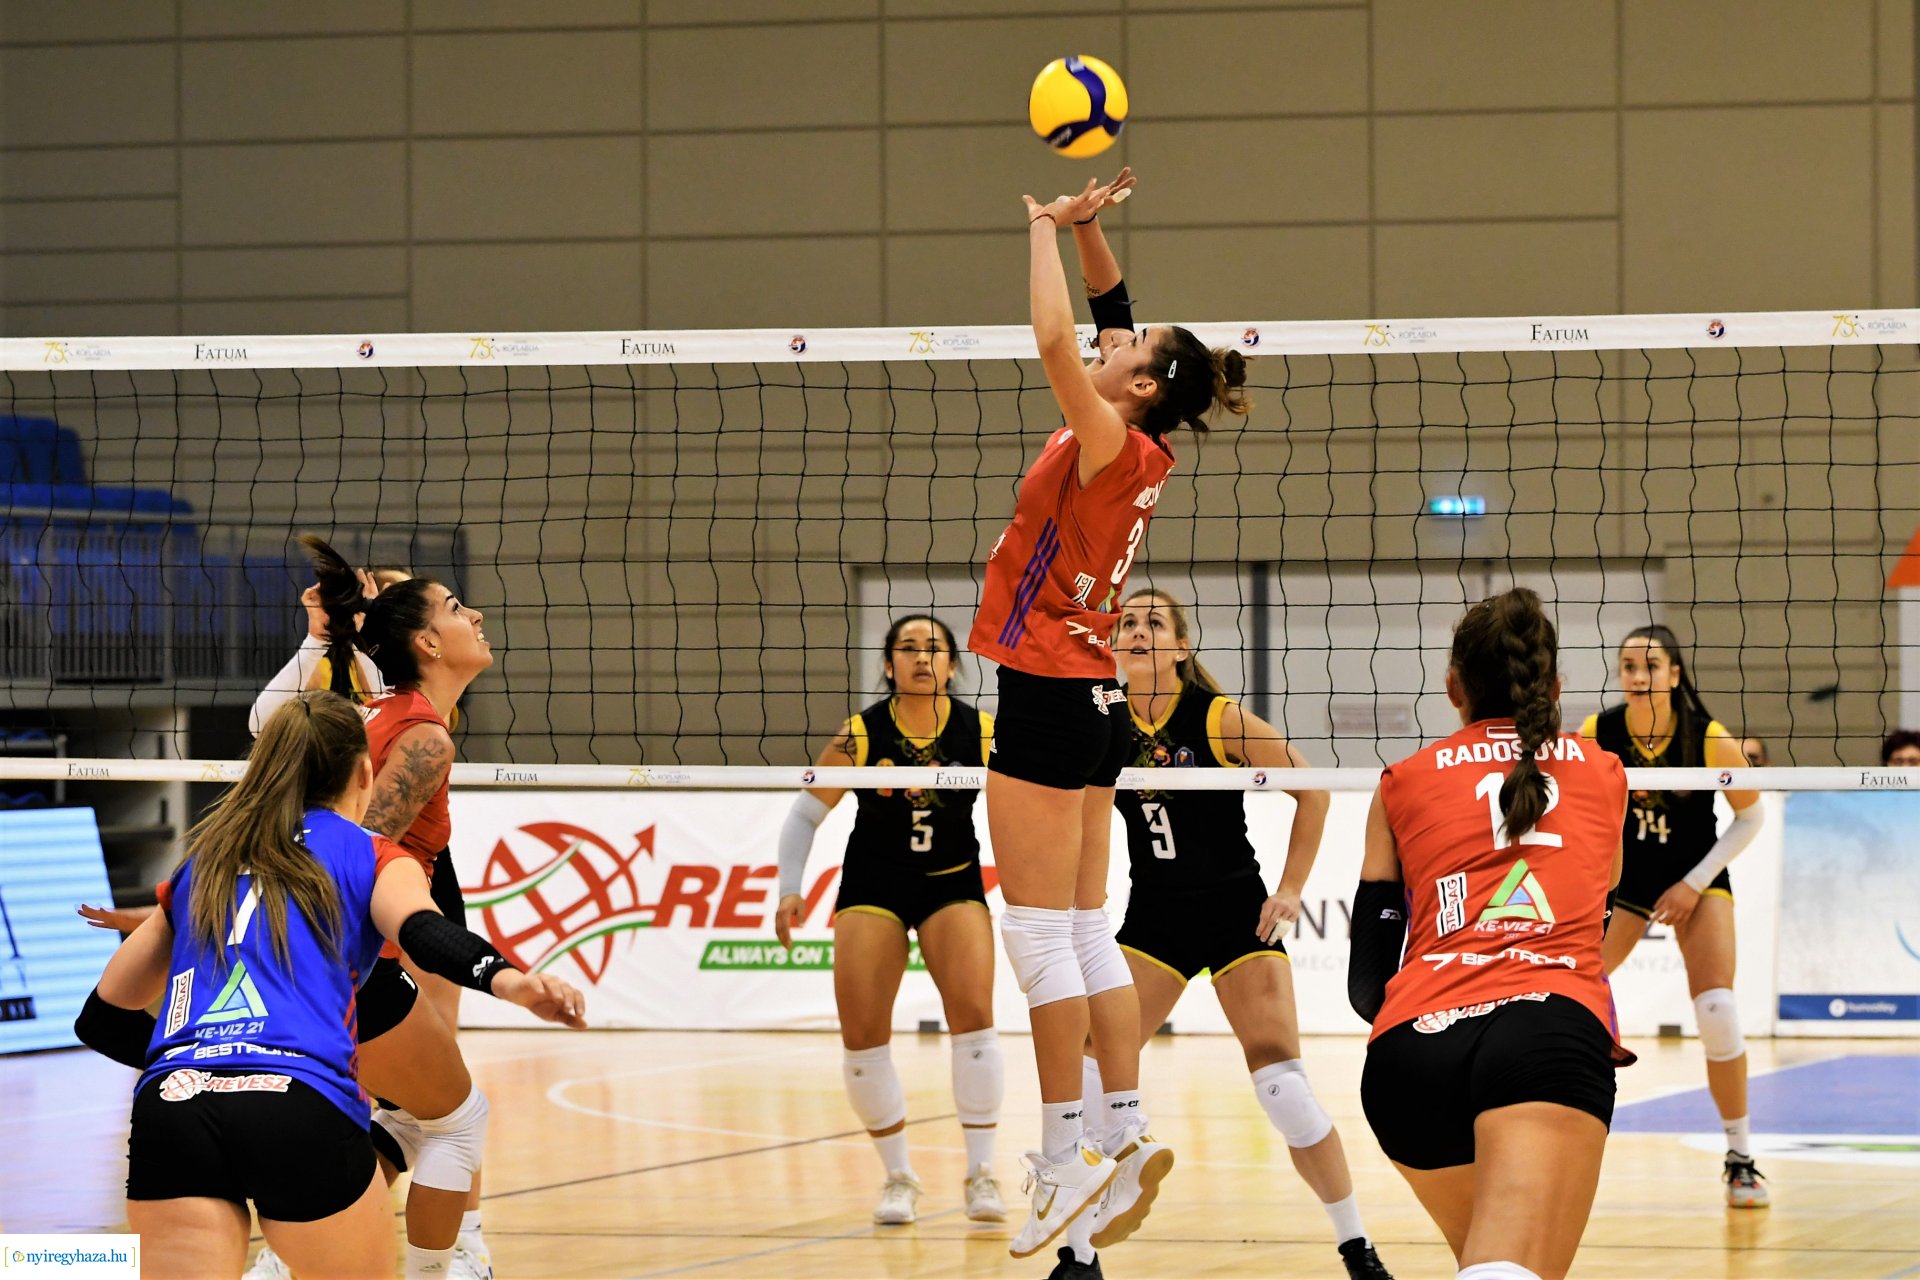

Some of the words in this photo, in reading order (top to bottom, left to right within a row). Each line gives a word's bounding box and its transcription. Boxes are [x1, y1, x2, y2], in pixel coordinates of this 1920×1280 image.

[1530, 324, 1589, 341] FATUM
[194, 344, 248, 360] FATUM
[621, 339, 676, 355] FATUM
[1110, 517, 1144, 584] 3
[67, 763, 110, 777] FATUM
[495, 768, 538, 782] FATUM
[935, 772, 980, 785] FATUM
[1860, 772, 1908, 785] FATUM
[1475, 772, 1563, 850] 12
[910, 810, 933, 852] 5
[1141, 803, 1177, 860] 9
[1633, 808, 1671, 844] 14
[1474, 920, 1532, 932] KE-VIZ
[706, 945, 788, 965] ALWAYS
[791, 945, 822, 965] ON
[173, 975, 188, 1032] STRABAG
[246, 1021, 265, 1034] 21
[207, 1075, 290, 1090] REVESZ
